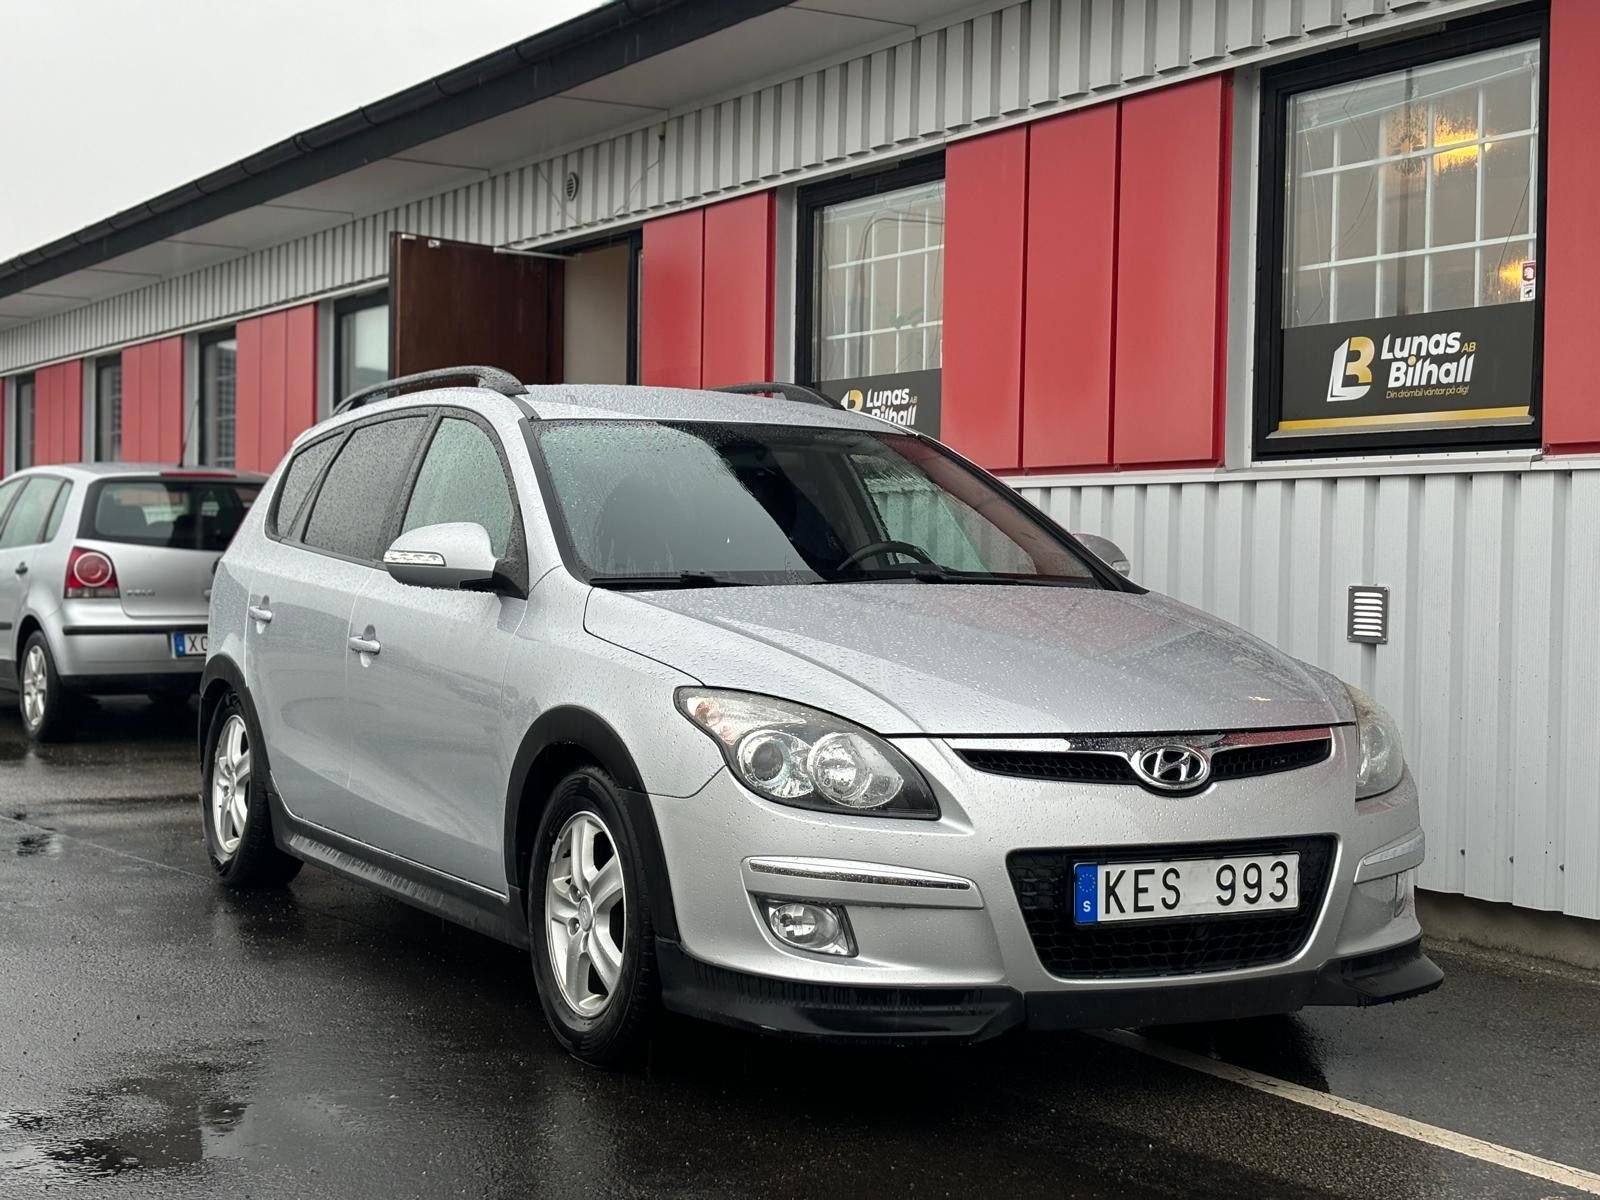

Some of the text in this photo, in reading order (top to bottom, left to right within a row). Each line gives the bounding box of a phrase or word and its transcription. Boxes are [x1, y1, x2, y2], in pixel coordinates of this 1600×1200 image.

[1381, 332, 1476, 360] Lunas AB
[1388, 354, 1475, 388] Bilhall
[866, 388, 910, 408] Lunas
[1386, 390, 1398, 399] Din
[1105, 861, 1288, 914] KES 993
[1083, 901, 1091, 912] S
